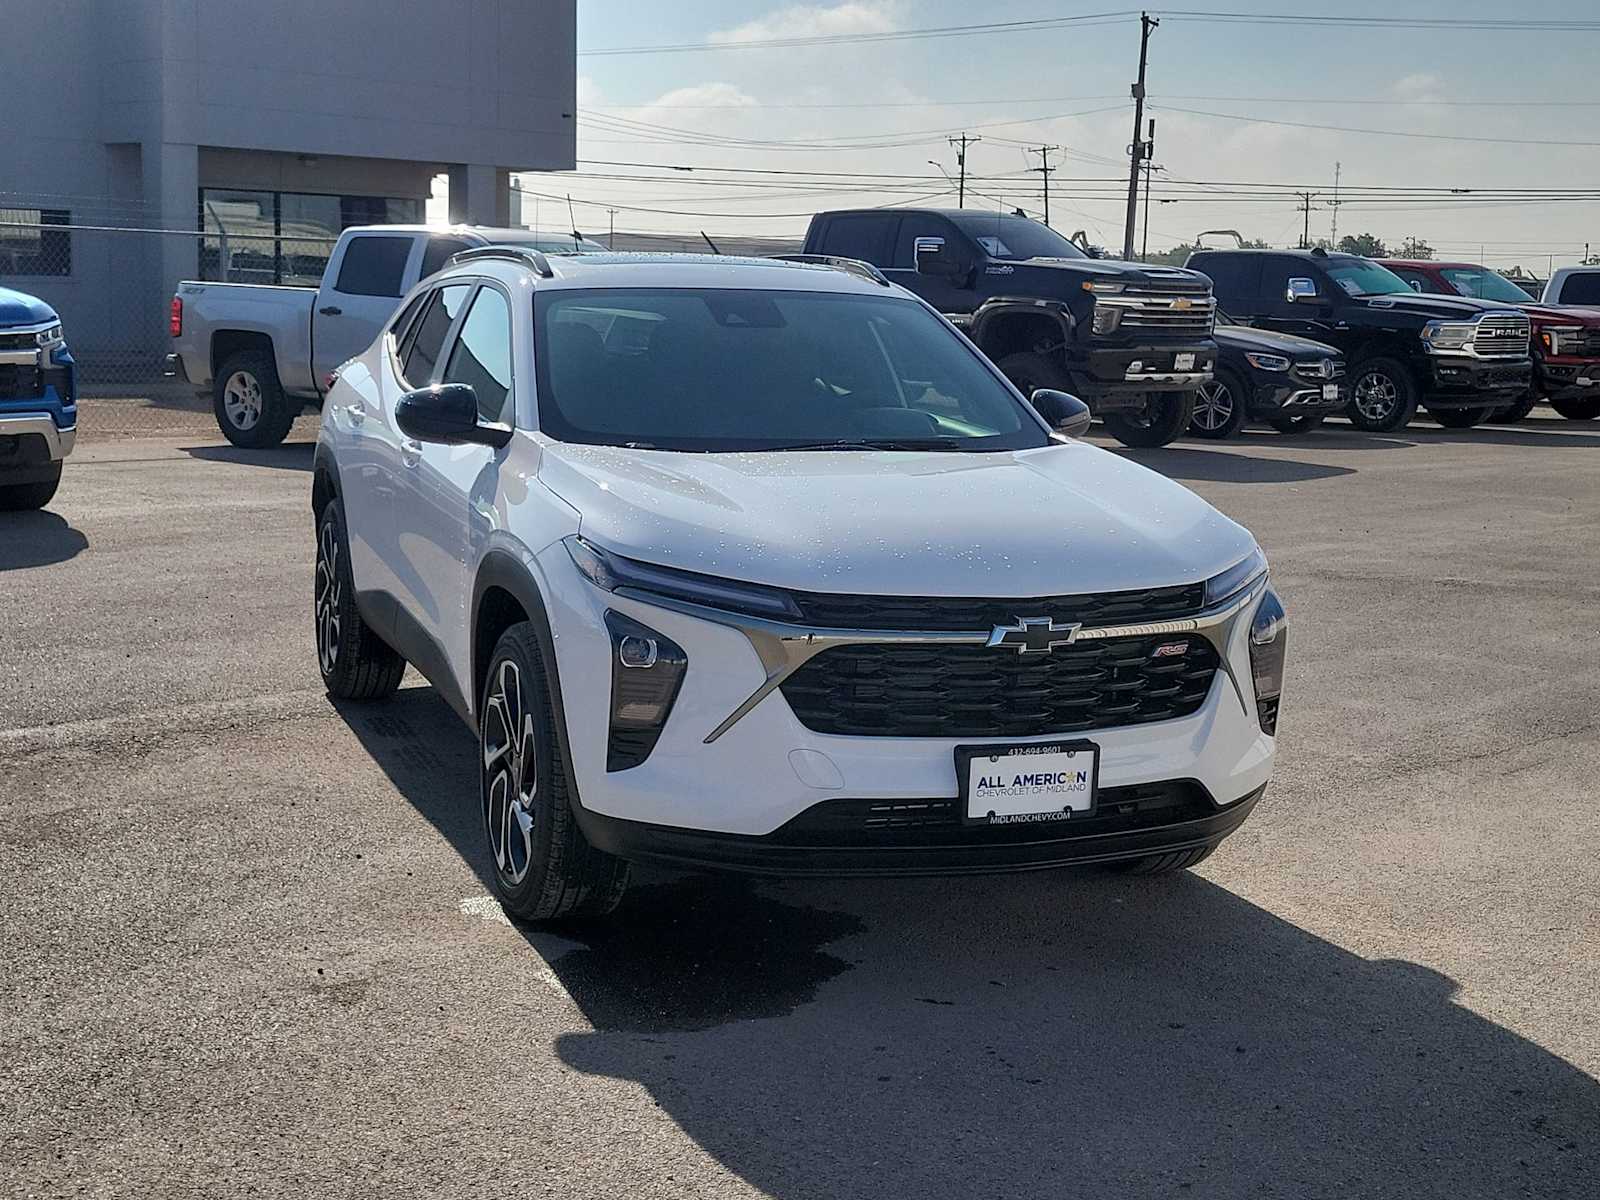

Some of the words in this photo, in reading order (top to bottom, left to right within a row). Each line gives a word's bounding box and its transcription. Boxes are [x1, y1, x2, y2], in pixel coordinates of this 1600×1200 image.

[1153, 644, 1189, 657] RS
[1008, 746, 1061, 755] 432-694-9601
[977, 776, 1005, 789] ALL
[976, 787, 1030, 798] CHEVROLET
[1032, 786, 1045, 794] OF
[1047, 783, 1086, 793] MIDLAND
[990, 812, 1071, 824] MIDLANDCHEVY.COM
